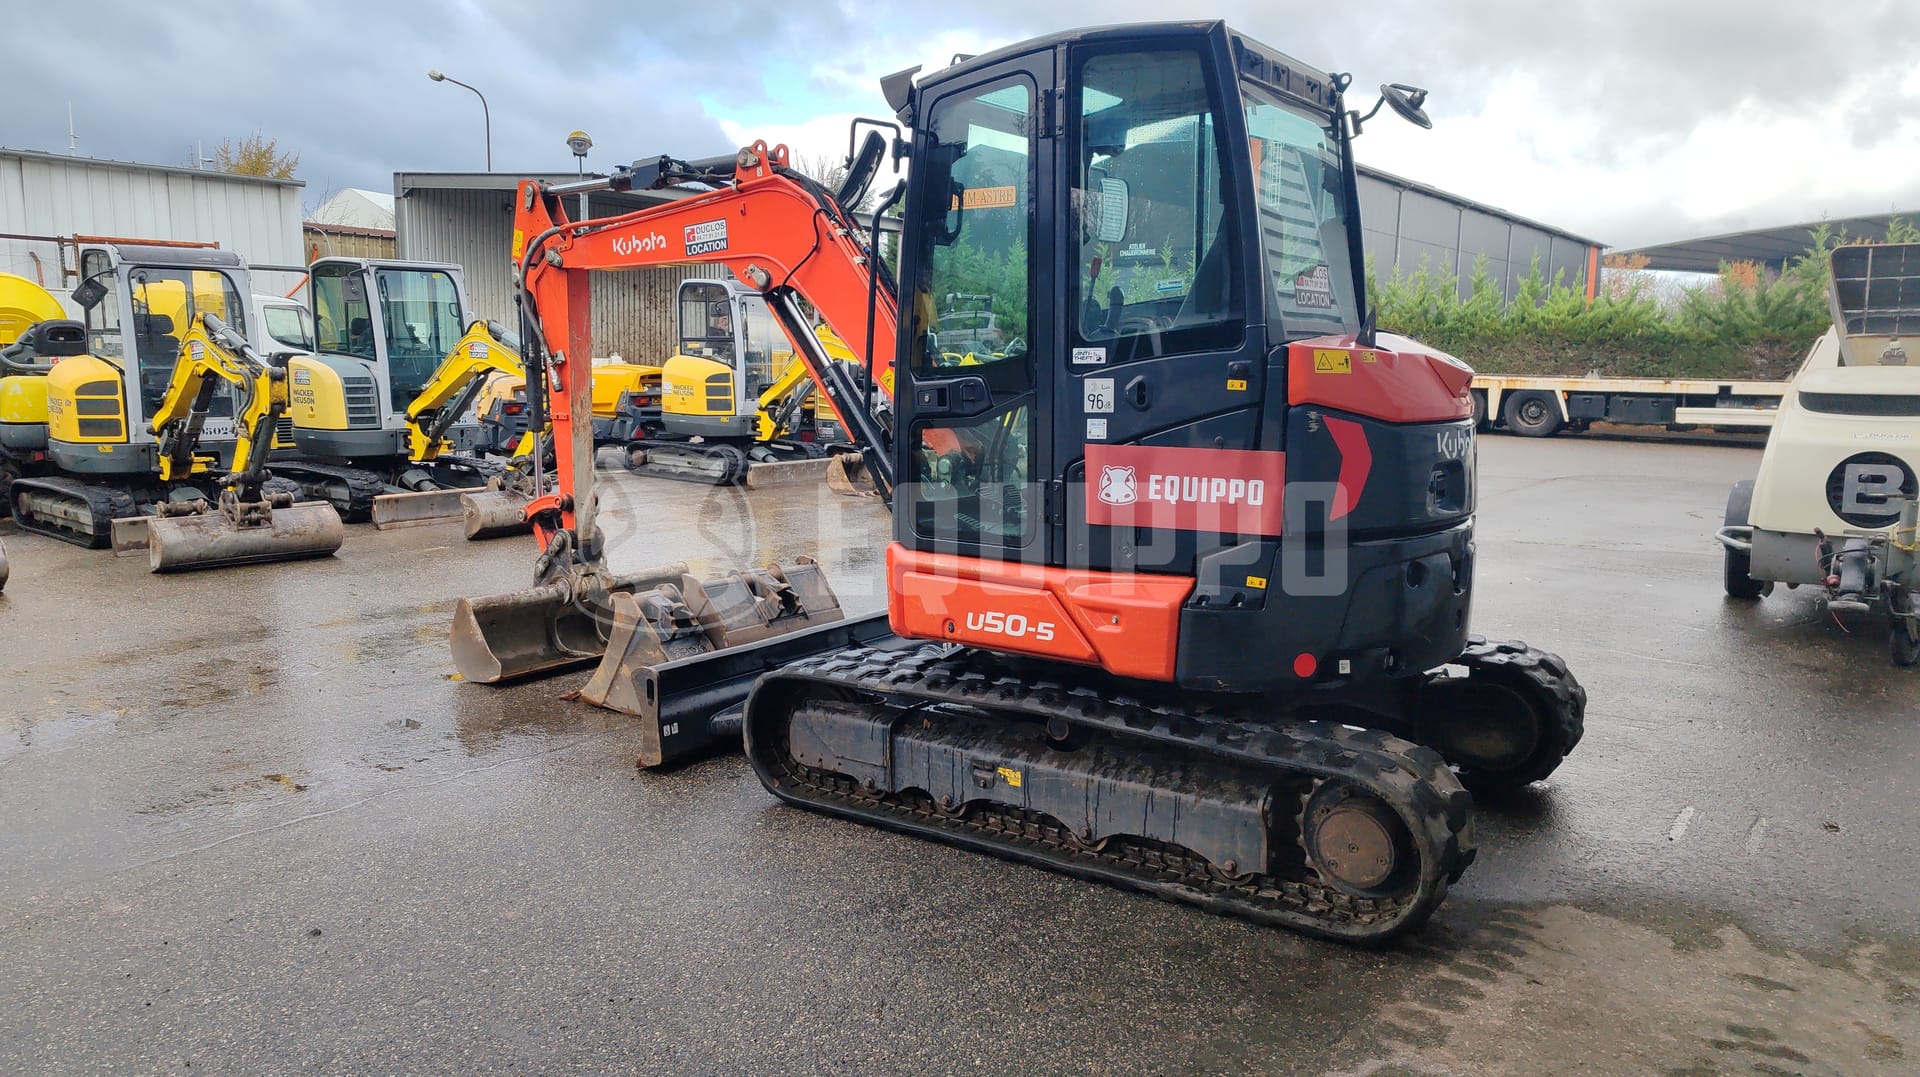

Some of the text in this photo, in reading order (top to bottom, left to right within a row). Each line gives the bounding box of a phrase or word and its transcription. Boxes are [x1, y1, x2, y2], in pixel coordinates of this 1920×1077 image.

[695, 222, 725, 235] DUCLOS
[612, 231, 667, 255] Kubota
[686, 239, 727, 255] LOCATION
[1296, 291, 1330, 307] LOCATION
[293, 389, 314, 397] WACKER
[293, 396, 315, 405] NEUSON
[1087, 393, 1104, 409] 96
[1148, 474, 1265, 506] EQUIPPO
[1841, 463, 1905, 516] B
[966, 611, 1055, 641] U50-5
